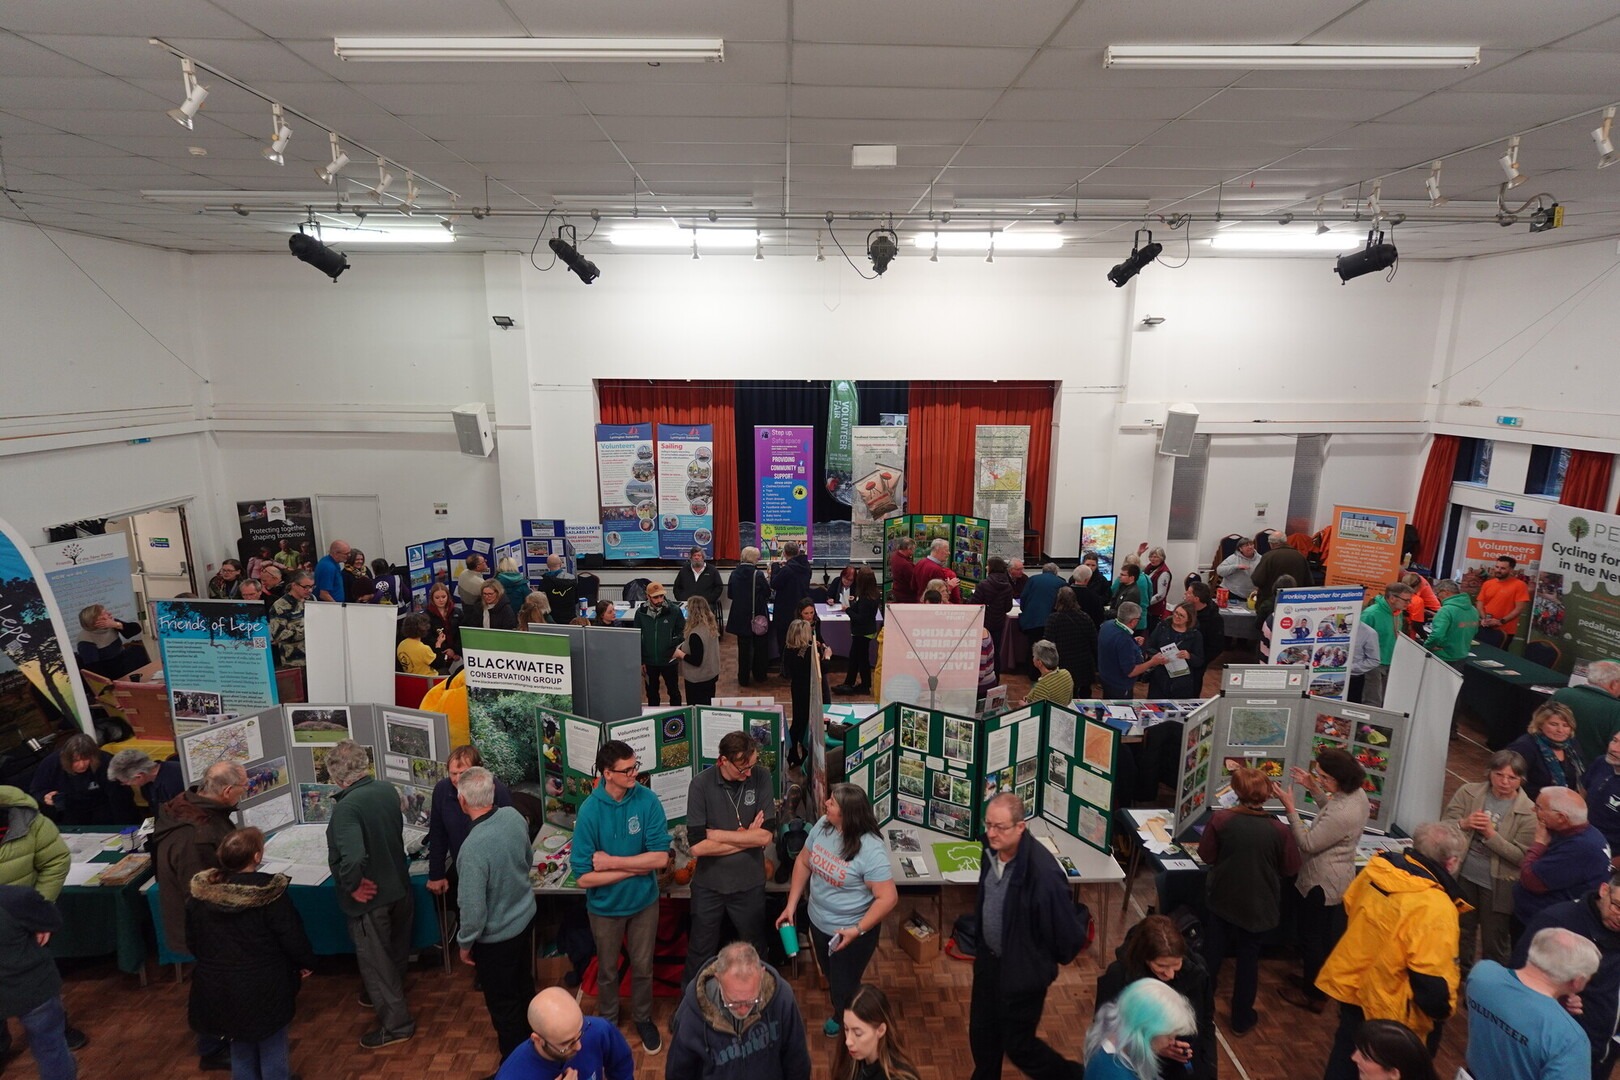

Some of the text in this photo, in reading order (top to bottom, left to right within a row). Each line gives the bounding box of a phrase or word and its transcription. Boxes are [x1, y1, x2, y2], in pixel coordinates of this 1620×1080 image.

[771, 429, 784, 437] Step
[839, 401, 850, 450] VOLUNTEER
[249, 524, 306, 534] Protecting together,
[1491, 522, 1544, 535] PEDALL
[252, 533, 276, 541] shaping
[1478, 541, 1535, 554] Volunteers
[1552, 542, 1620, 567] Cycling for
[1559, 558, 1620, 583] in the Ne
[159, 615, 263, 639] Friends of Lepe
[467, 656, 564, 675] BLACKWATER
[470, 670, 562, 685] CONSERVATION GROUP
[617, 726, 649, 736] Volunteering
[620, 733, 650, 742] pportunities
[808, 851, 847, 881] FOXIE'S
[831, 853, 851, 868] ABOUT
